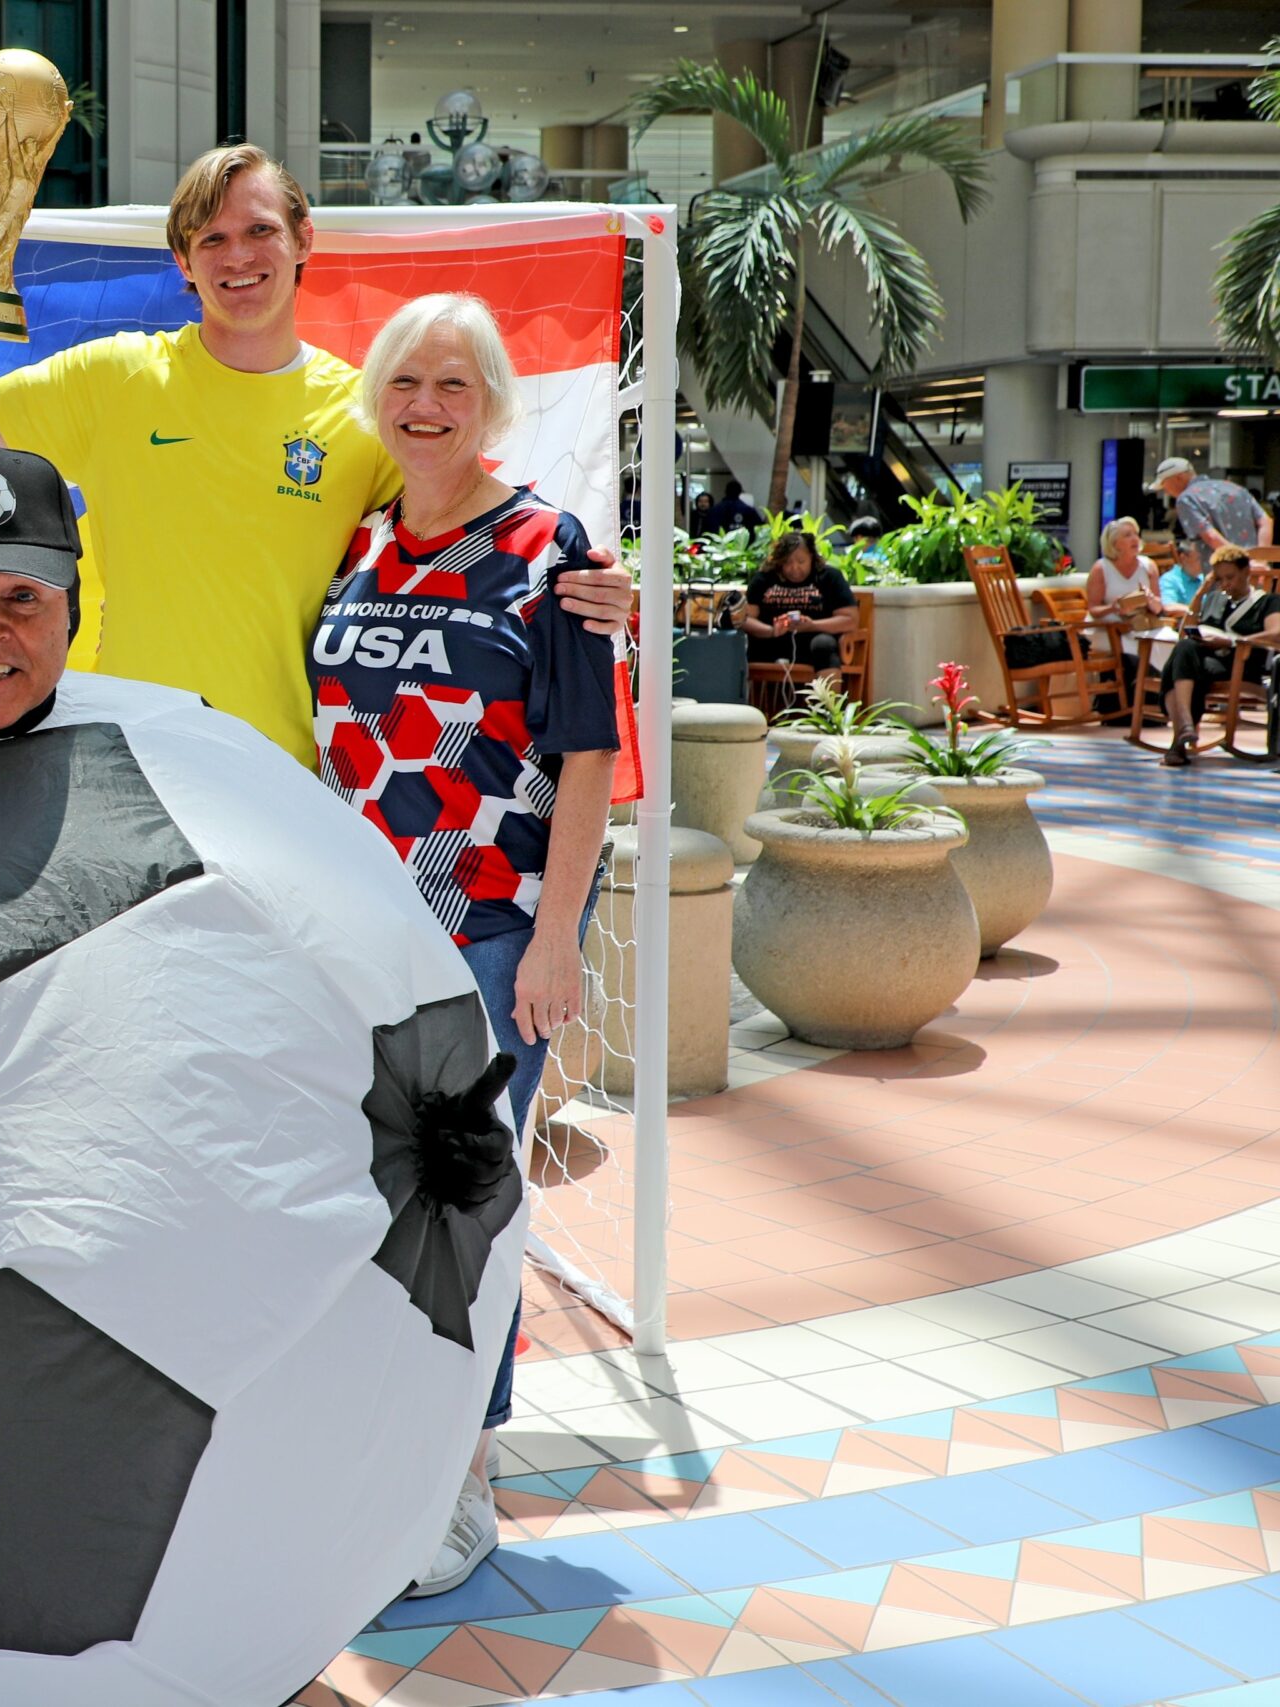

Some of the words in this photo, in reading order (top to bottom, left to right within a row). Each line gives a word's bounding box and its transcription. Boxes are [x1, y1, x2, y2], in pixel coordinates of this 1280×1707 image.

[296, 456, 311, 465] CBF
[277, 485, 322, 503] BRASIL
[343, 602, 409, 619] WORLD
[409, 605, 449, 620] CUP
[448, 608, 494, 628] 26
[313, 624, 453, 675] USA
